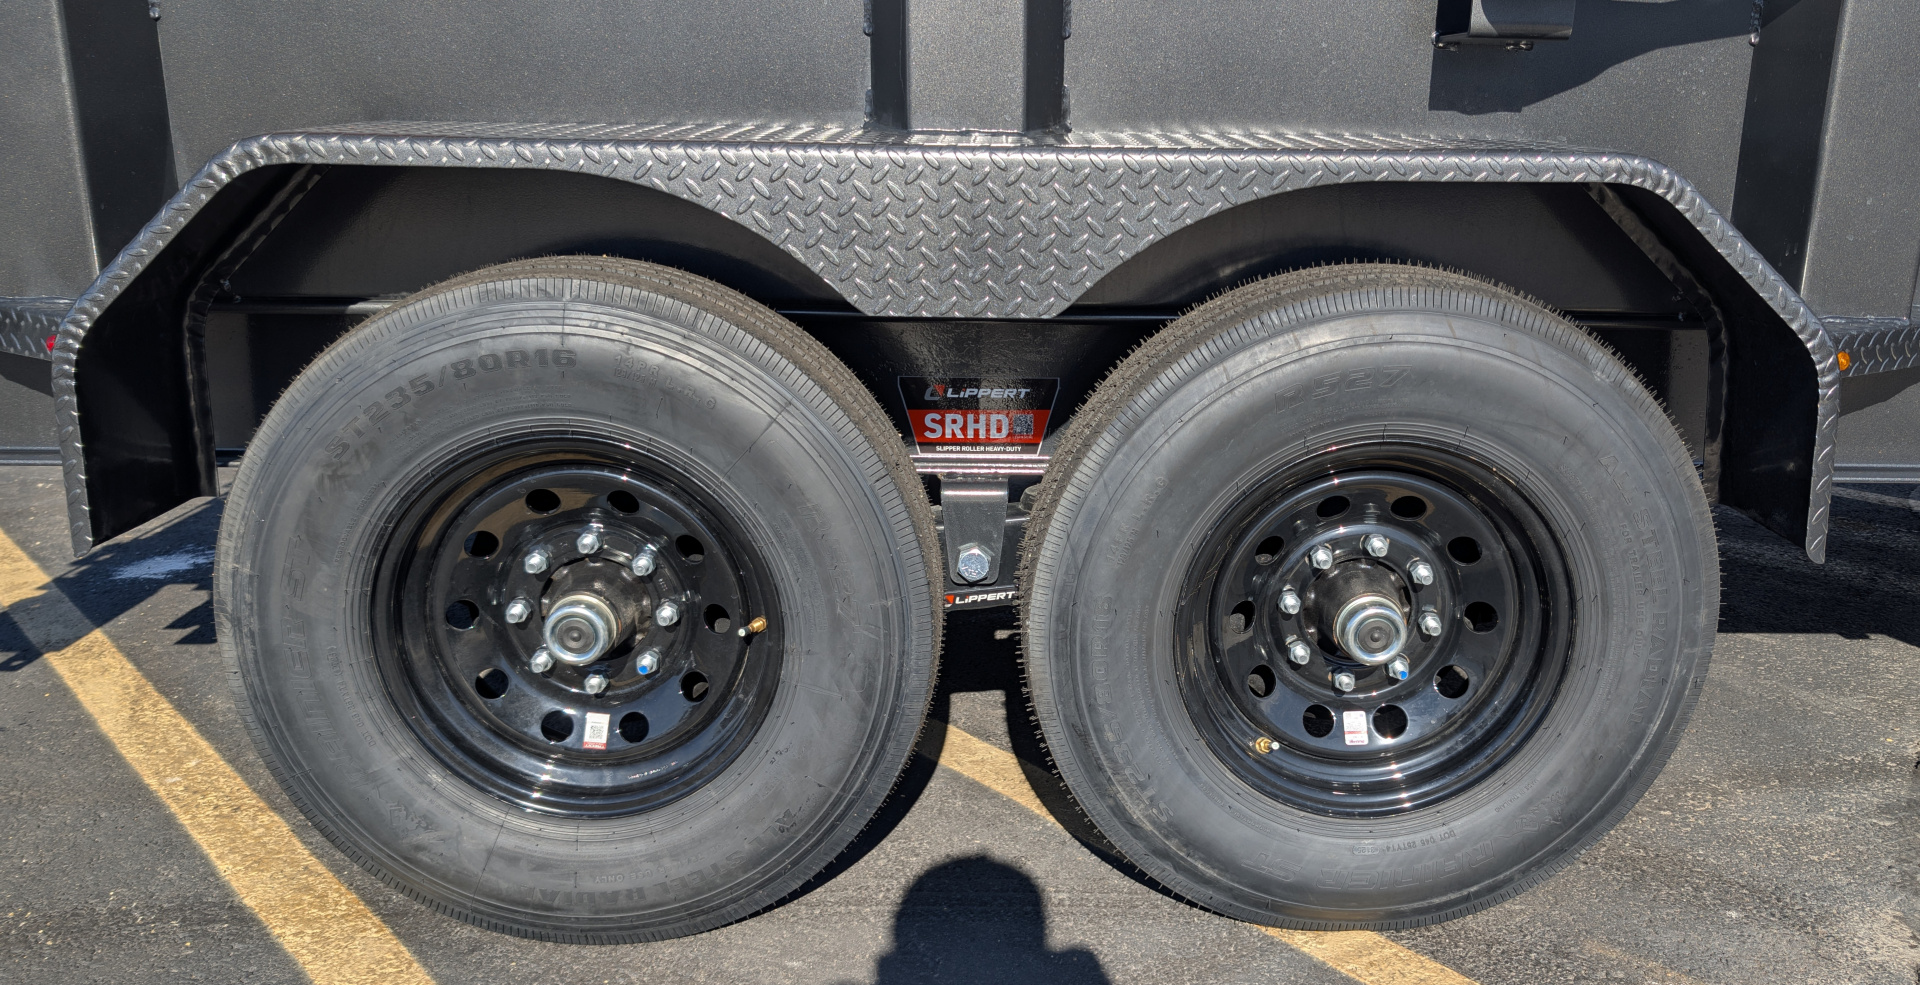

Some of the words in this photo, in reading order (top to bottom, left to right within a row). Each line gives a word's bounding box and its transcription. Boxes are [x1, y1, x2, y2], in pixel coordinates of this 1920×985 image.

[321, 344, 577, 462] ST235/80R16
[924, 413, 1009, 439] SRHD
[1599, 452, 1643, 506] ALL
[1618, 522, 1633, 544] FOR
[1631, 506, 1670, 603] STEEL
[1627, 549, 1645, 596] TRAILER
[1635, 602, 1644, 623] USE
[1631, 630, 1643, 657] ONLY
[1625, 611, 1668, 730] RADIAL
[1437, 829, 1456, 841] DOT
[593, 872, 623, 885] ONLY
[652, 846, 748, 900] STEEL
[1240, 844, 1302, 886] ST
[1314, 838, 1500, 892] RAINIER
